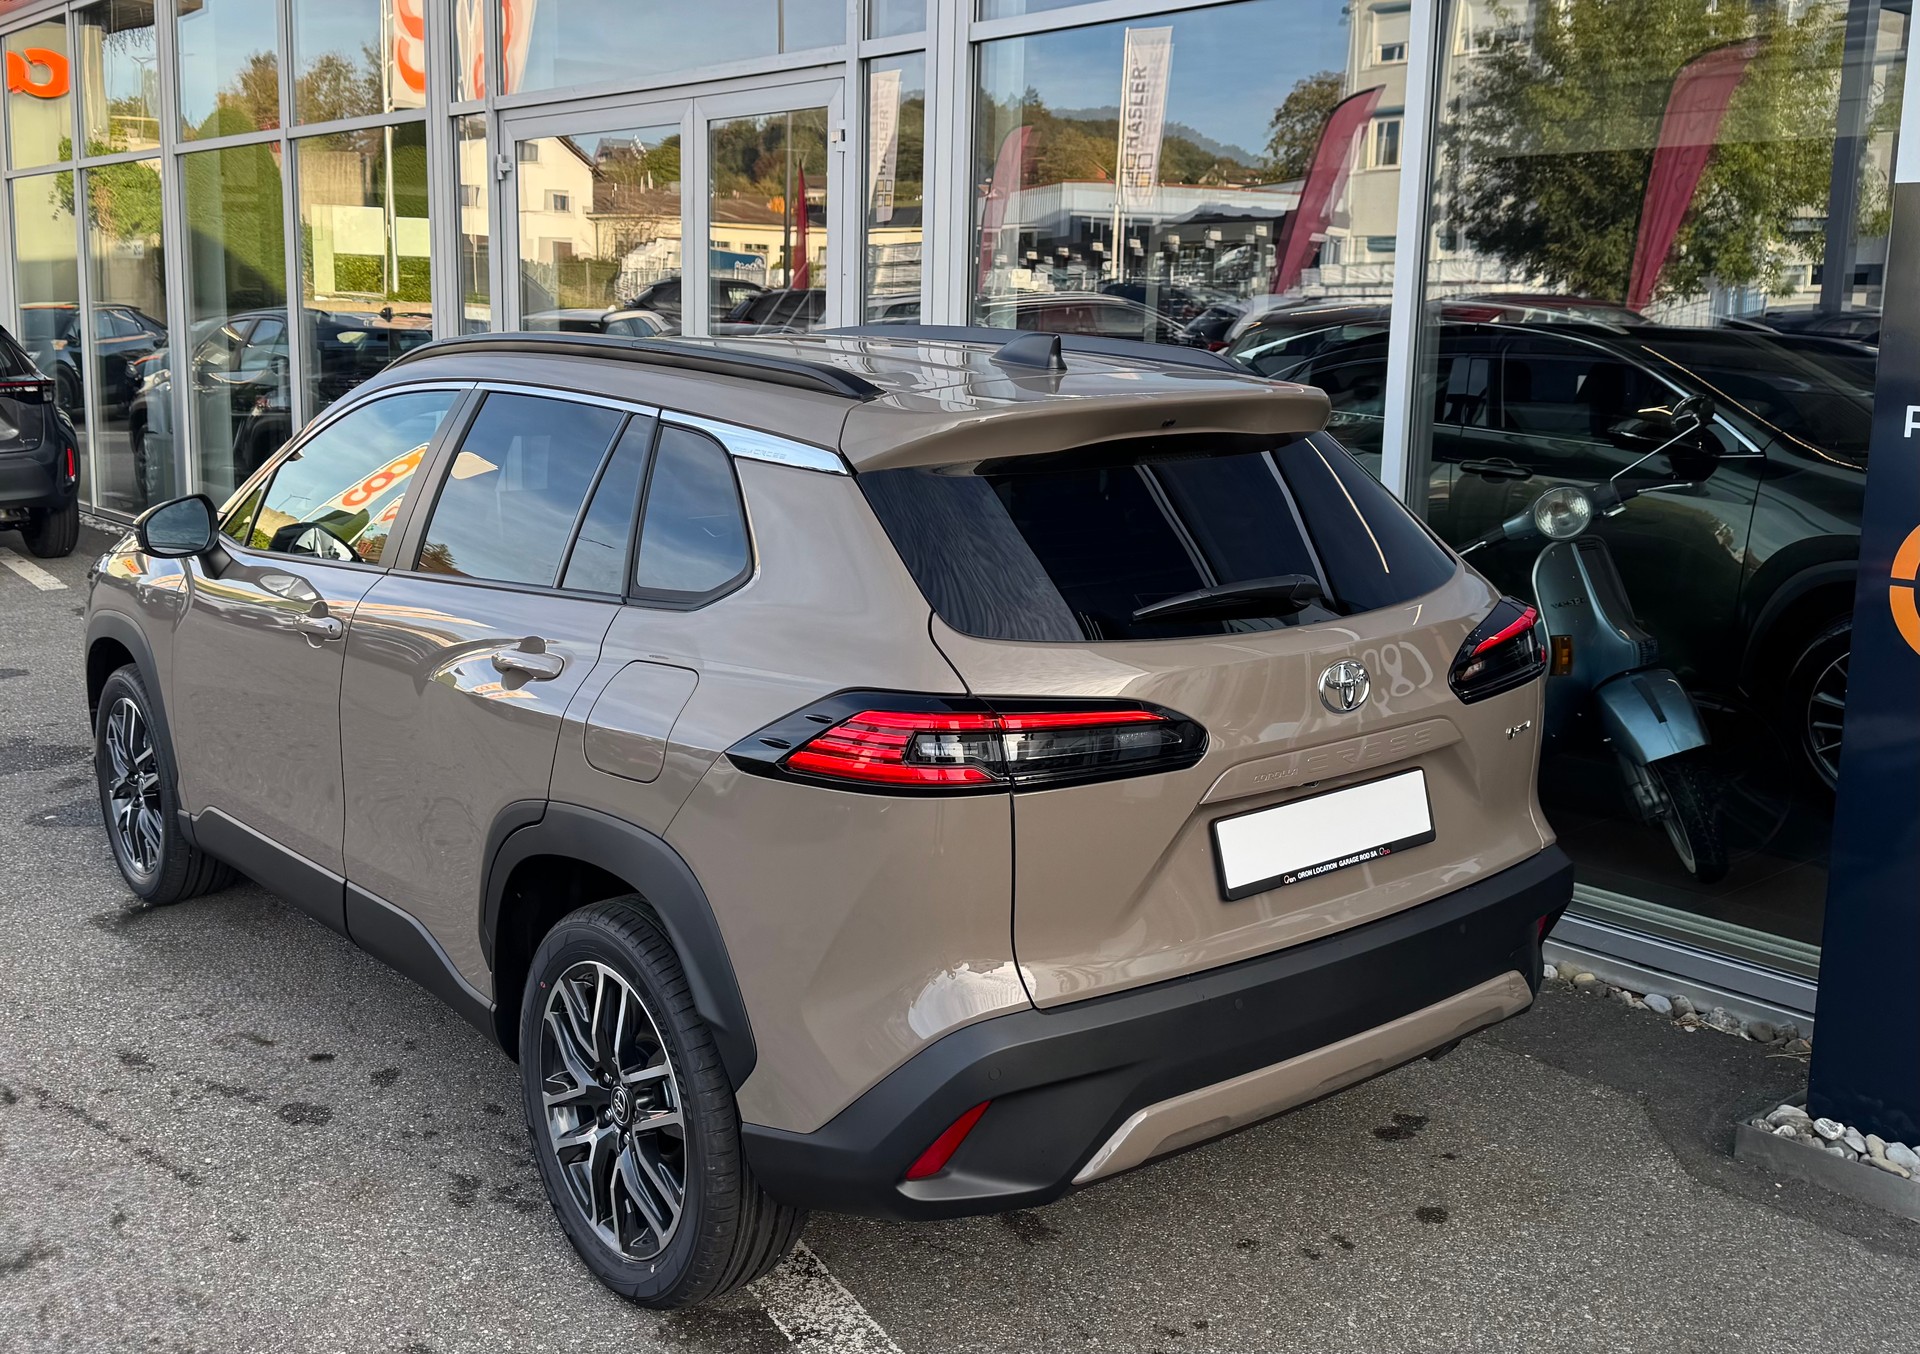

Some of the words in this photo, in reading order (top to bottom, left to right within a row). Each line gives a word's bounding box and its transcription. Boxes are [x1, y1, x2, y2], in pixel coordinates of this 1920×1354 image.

[1127, 65, 1147, 148] HASLER
[1312, 861, 1338, 875] LOCATION
[1338, 855, 1360, 867] GARAGE
